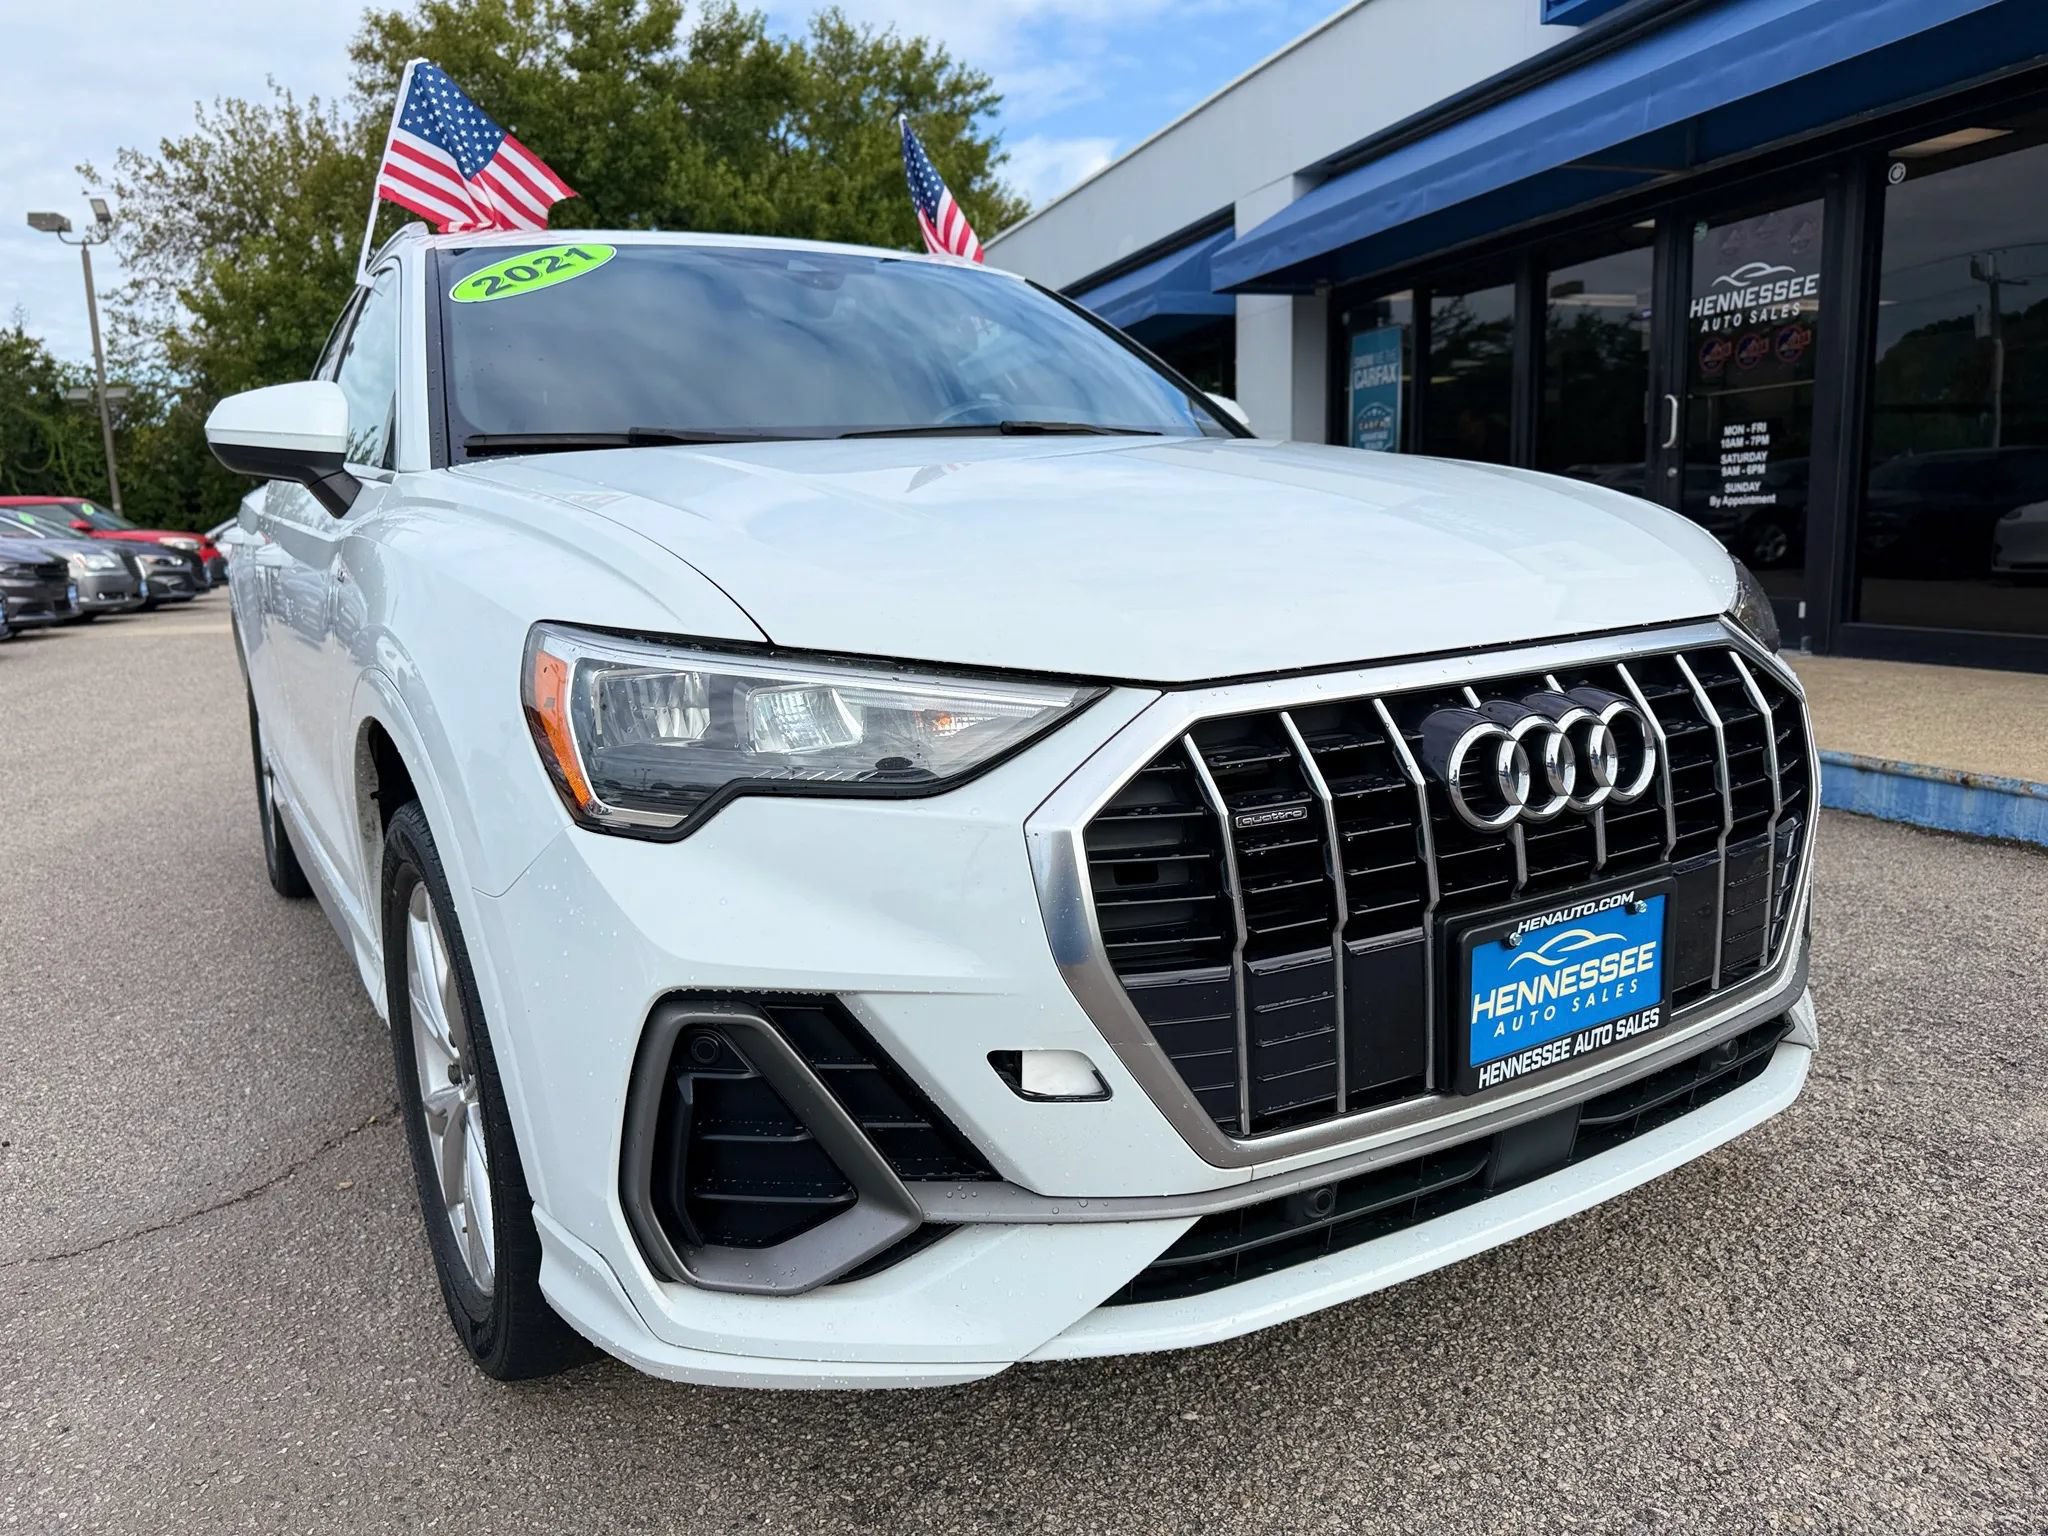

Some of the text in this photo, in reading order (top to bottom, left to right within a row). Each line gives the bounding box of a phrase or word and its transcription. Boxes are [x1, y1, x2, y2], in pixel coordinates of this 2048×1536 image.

[472, 247, 597, 297] 2021
[1689, 273, 1820, 319] HENNESSEE
[1700, 301, 1801, 333] AUTO SALES
[1354, 362, 1397, 390] CARFAX
[1720, 437, 1744, 448] 10AM
[1750, 434, 1770, 446] 7PM
[1723, 425, 1745, 436] MON
[1751, 422, 1767, 433] FRI
[1720, 451, 1768, 465] SATURDAY
[1709, 494, 1776, 508] By Appointment
[1724, 481, 1761, 493] SUNDAY
[1242, 810, 1303, 825] quattro
[1517, 890, 1635, 934] HENAUTO.COM
[1472, 940, 1657, 1024] HENNESSEE
[1494, 978, 1638, 1037] AUTO SALES
[1478, 1008, 1660, 1089] HENNESSEE AUTO SALES
